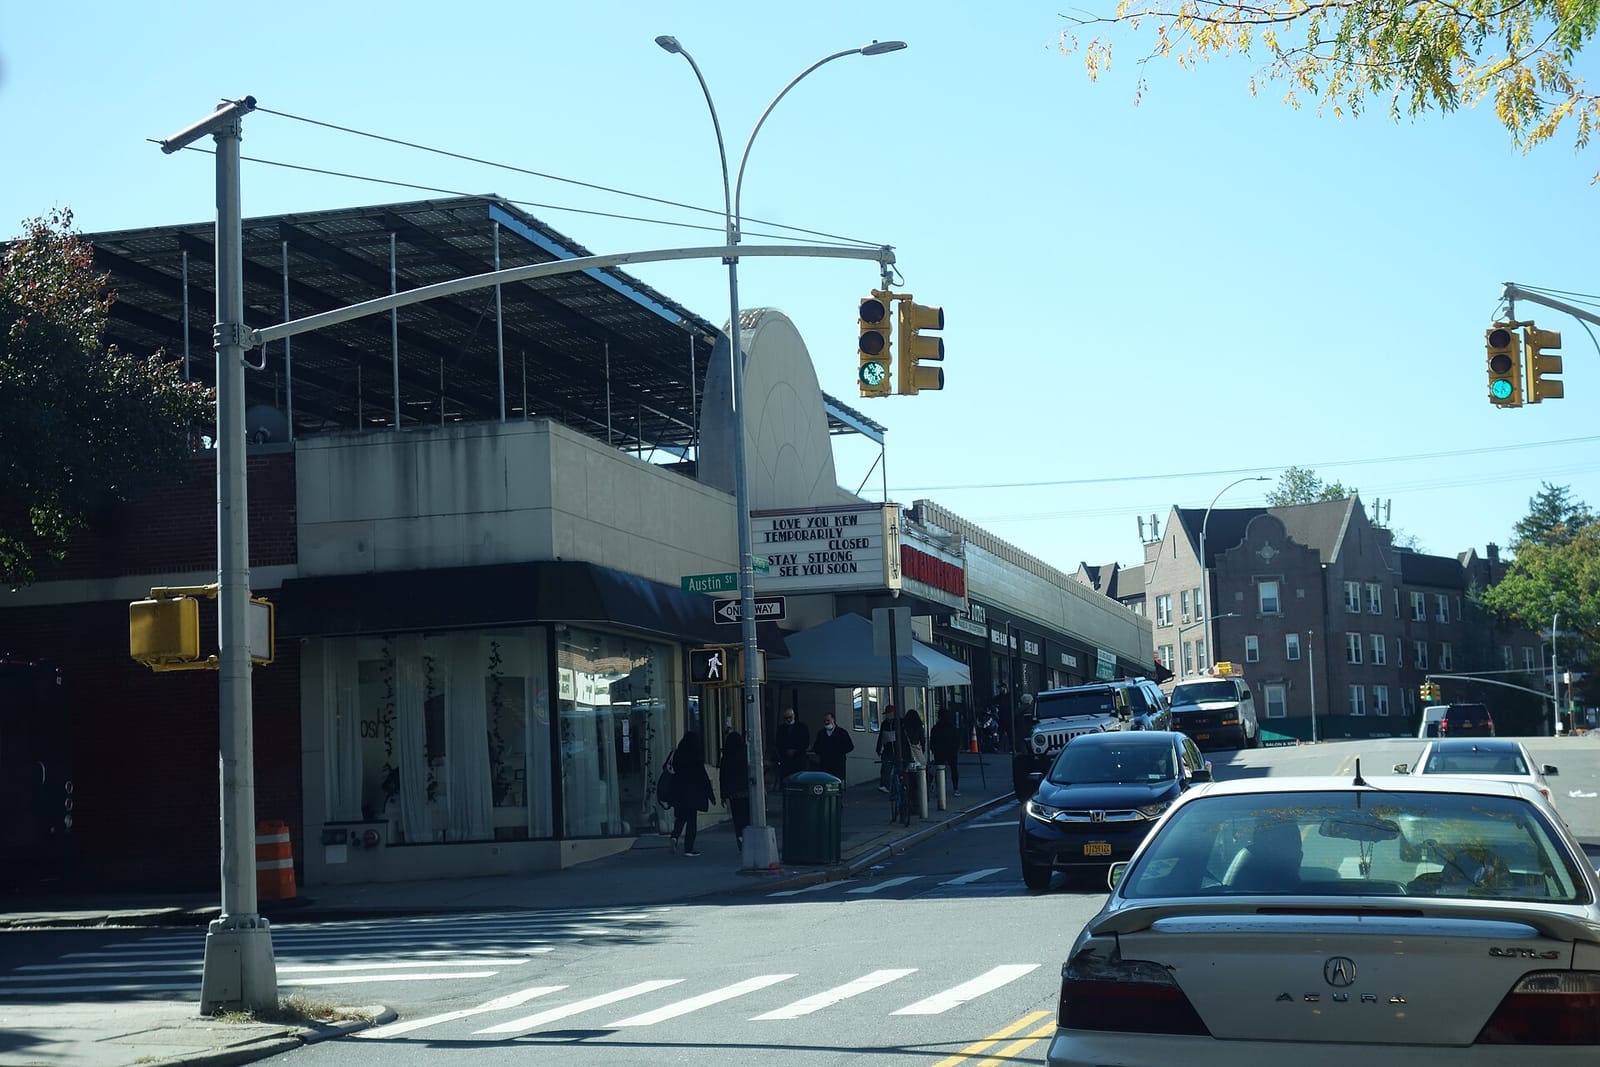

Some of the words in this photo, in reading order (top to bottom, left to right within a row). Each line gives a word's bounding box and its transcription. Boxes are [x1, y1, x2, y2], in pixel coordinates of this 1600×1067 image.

[773, 518, 801, 530] LOVE
[807, 517, 829, 528] YOU
[835, 515, 858, 527] KEW
[764, 527, 843, 543] TEMPORARILY
[828, 538, 869, 550] CLOSED
[768, 554, 798, 566] STAY
[808, 551, 853, 563] STRONG
[779, 566, 799, 577] SEE
[802, 565, 824, 575] YOU
[827, 562, 857, 574] SOON
[688, 576, 721, 591] Austin
[725, 575, 732, 584] St
[755, 603, 774, 614] WAY
